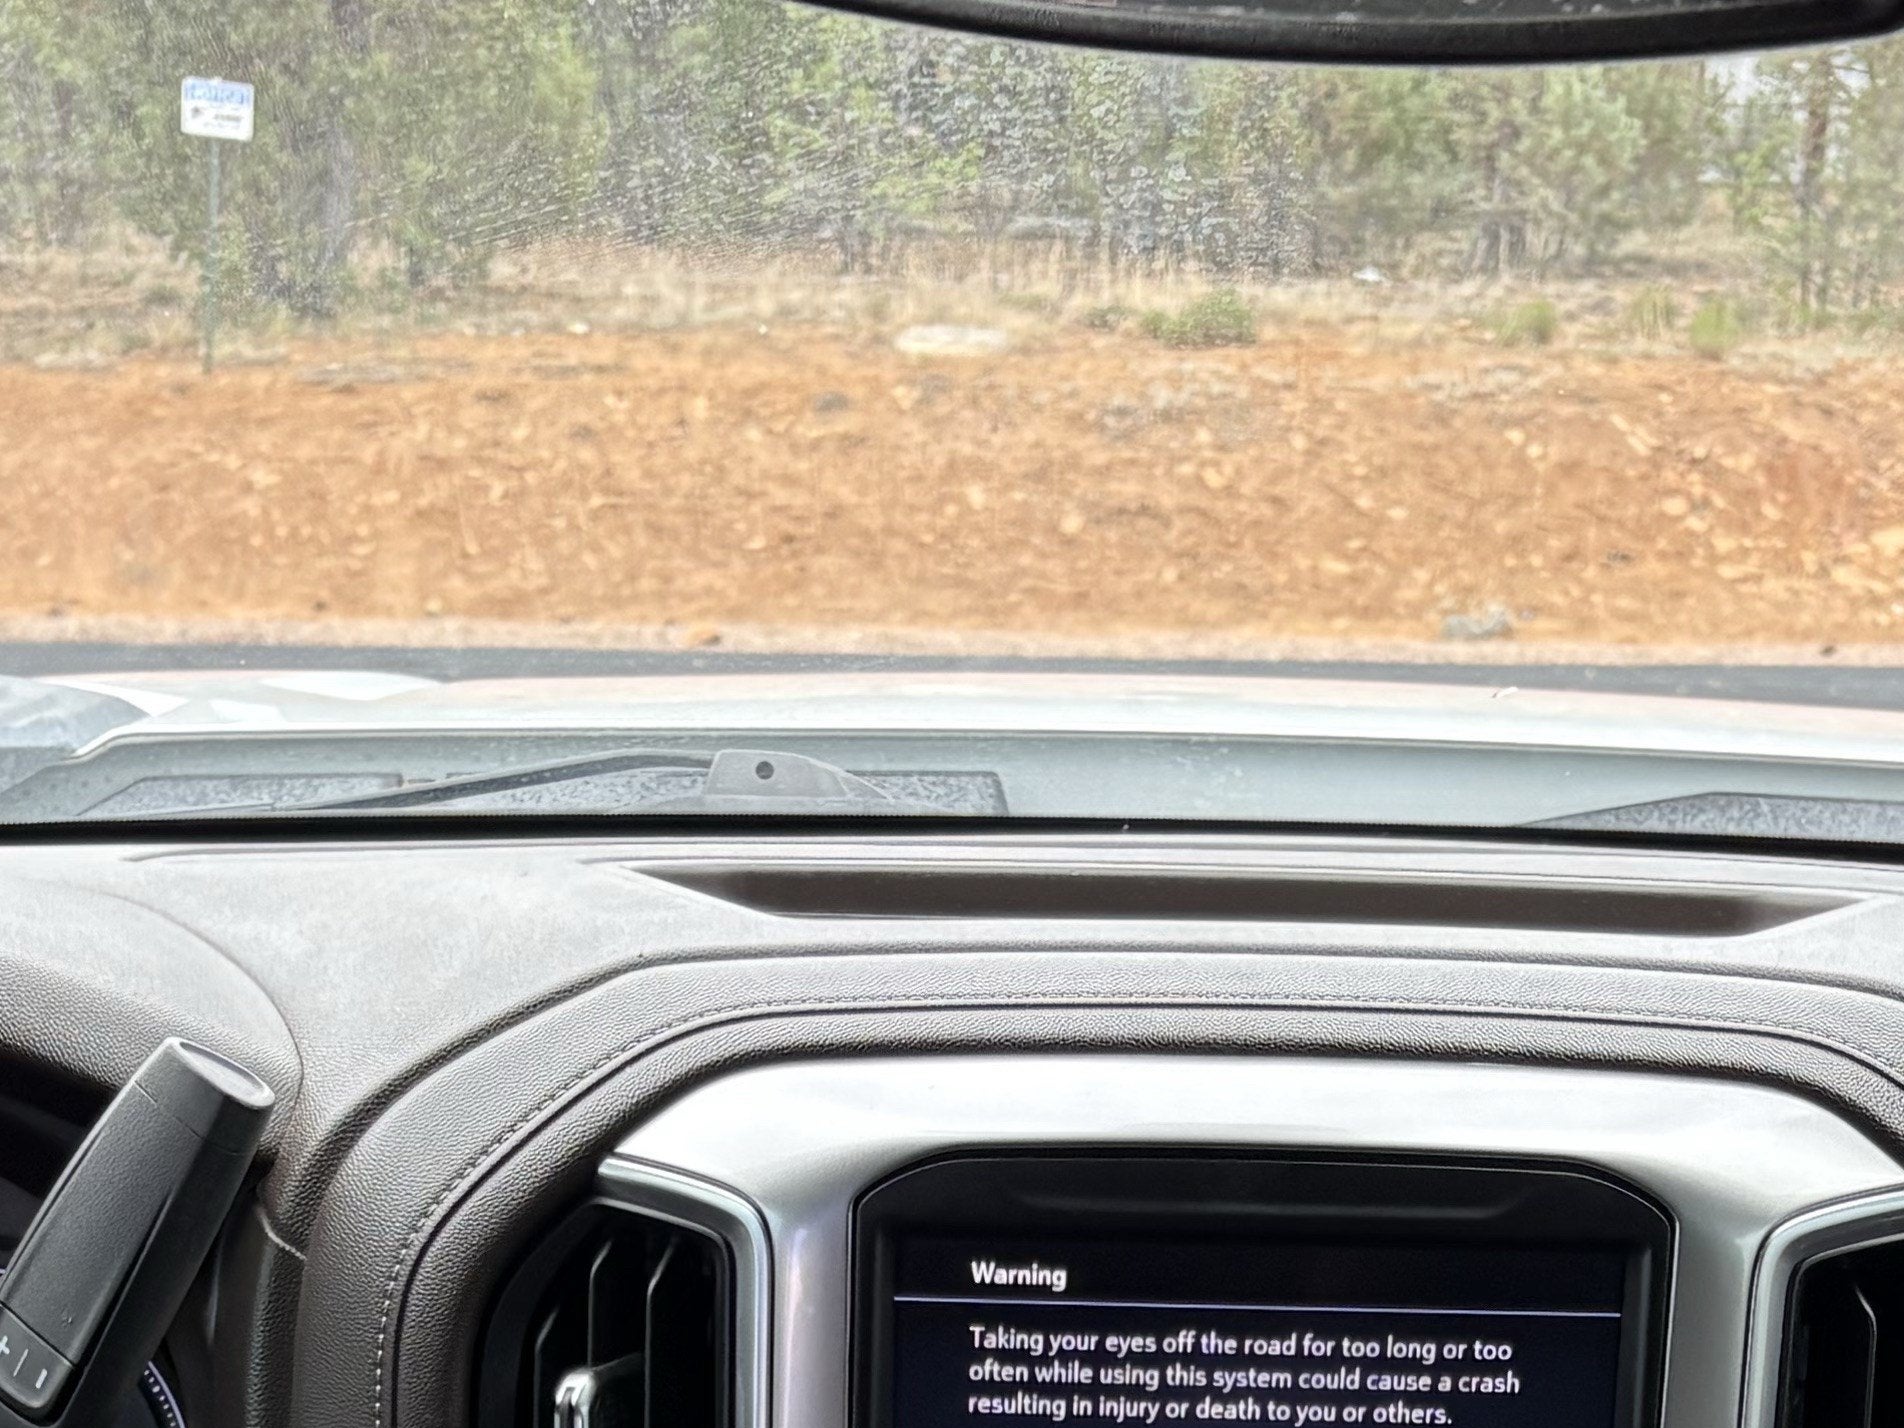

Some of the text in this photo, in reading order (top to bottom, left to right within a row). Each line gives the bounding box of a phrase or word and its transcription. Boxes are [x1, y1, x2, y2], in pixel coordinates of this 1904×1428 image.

[971, 1260, 1067, 1292] Warning
[969, 1325, 1513, 1365] Taking your eyes off the road for too long or too
[968, 1357, 1520, 1394] often while using this system could cause a crash
[967, 1391, 1452, 1428] resulting in injury or death to you or others.
